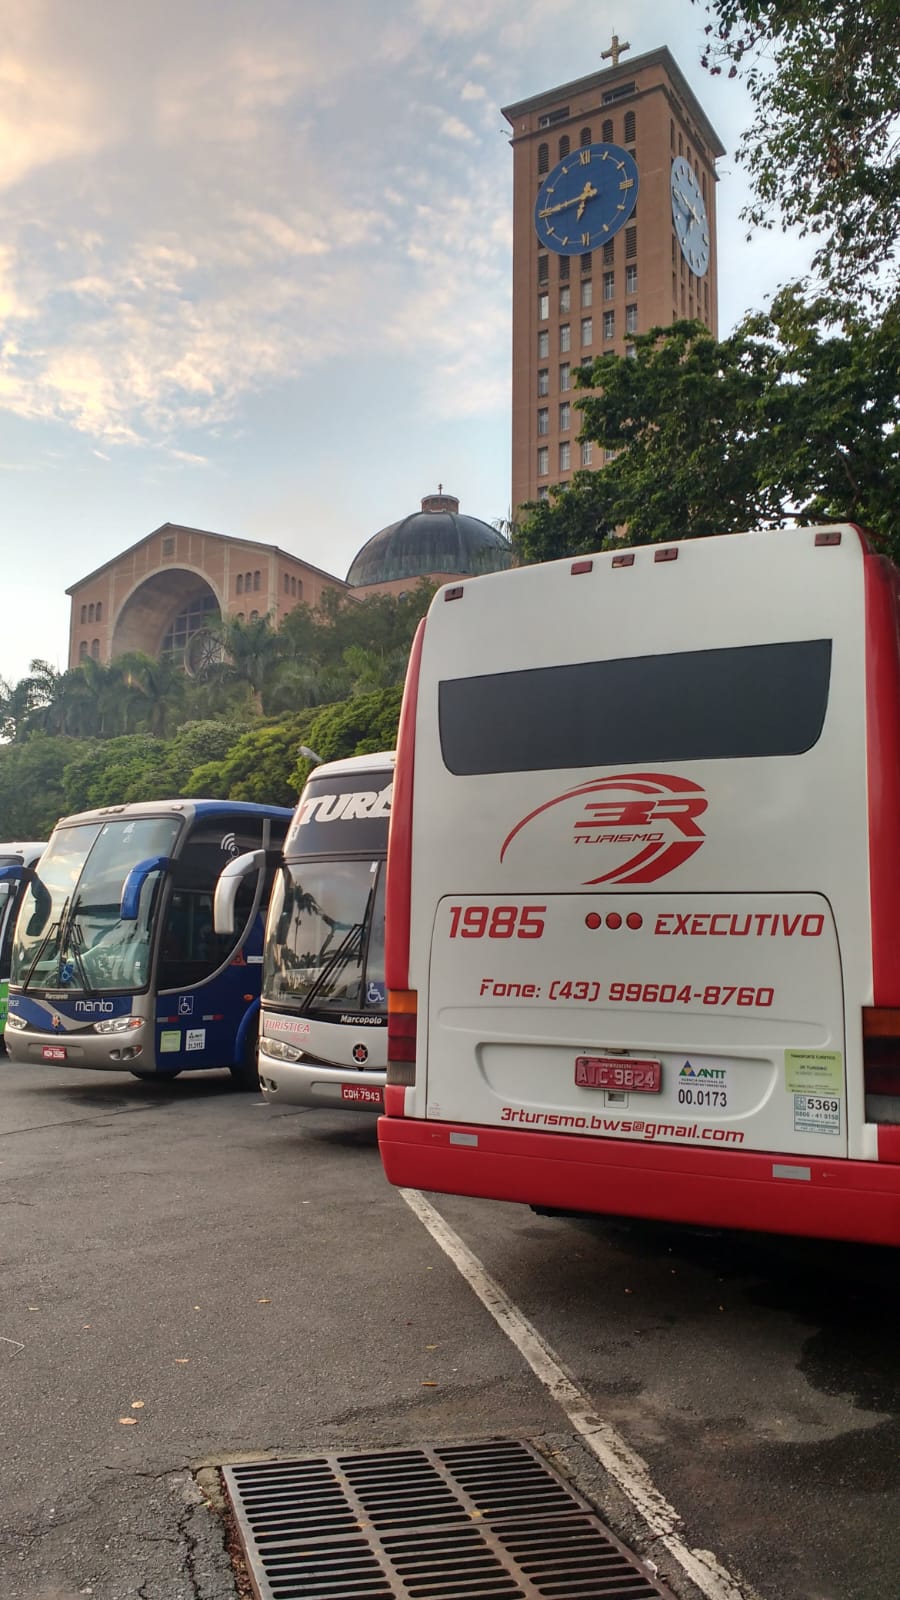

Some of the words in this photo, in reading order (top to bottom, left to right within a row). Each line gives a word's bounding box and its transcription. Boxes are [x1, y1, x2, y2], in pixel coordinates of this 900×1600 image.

[574, 798, 708, 836] 3R
[573, 832, 664, 844] TURISMO
[449, 906, 547, 938] 1985
[654, 914, 824, 937] EXECUTIVO
[480, 979, 541, 998] Fone:
[548, 981, 600, 1002] (43)
[608, 983, 774, 1007] 99604-8760
[76, 999, 114, 1012] manto
[340, 1014, 382, 1025] Marcopolo
[697, 1068, 726, 1078] ANTT
[678, 1088, 727, 1107] 00.0173
[807, 1098, 838, 1112] 5369
[500, 1108, 744, 1143] 3rturismo.bws@gmail.com
